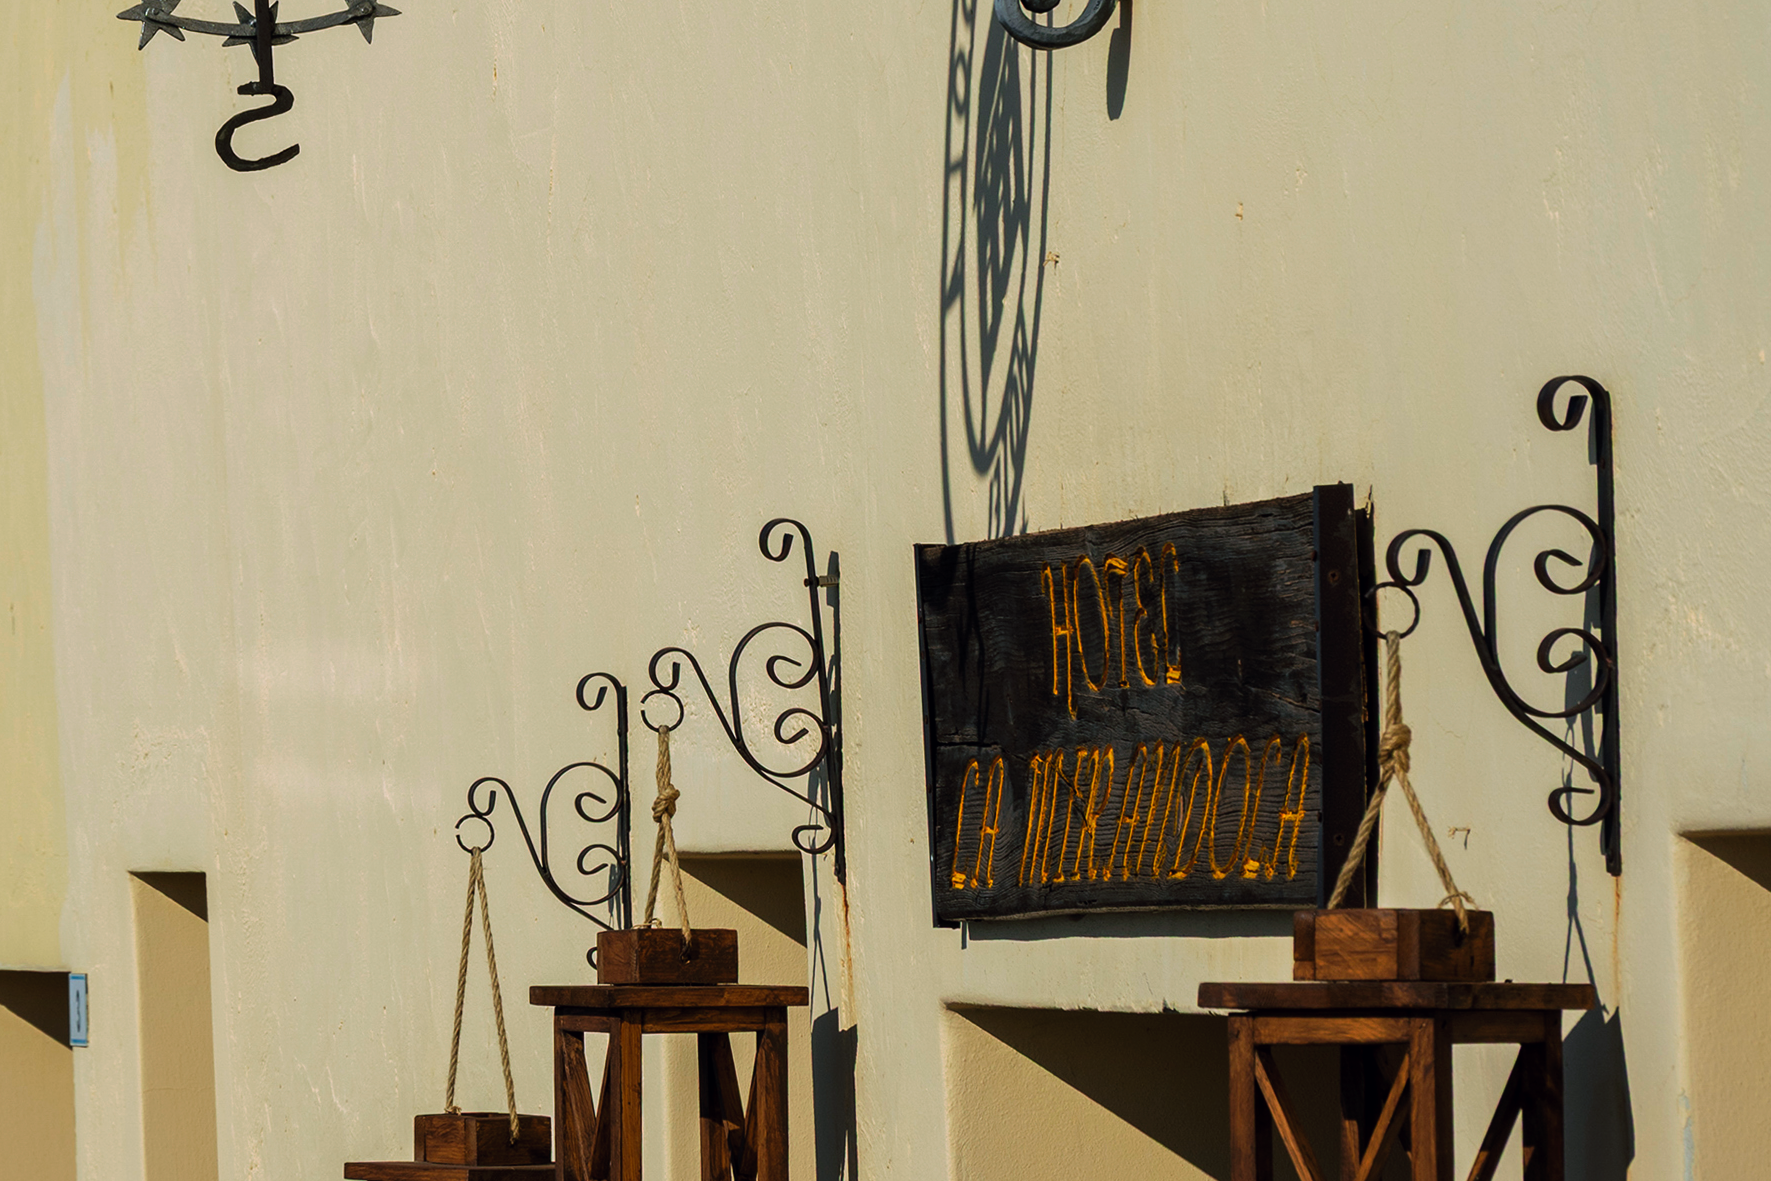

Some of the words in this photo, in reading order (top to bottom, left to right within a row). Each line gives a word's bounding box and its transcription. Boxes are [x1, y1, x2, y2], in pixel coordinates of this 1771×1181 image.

[1040, 541, 1184, 721] HOTEL
[950, 756, 1005, 891] LA
[1017, 731, 1310, 888] MIRANDOLA
